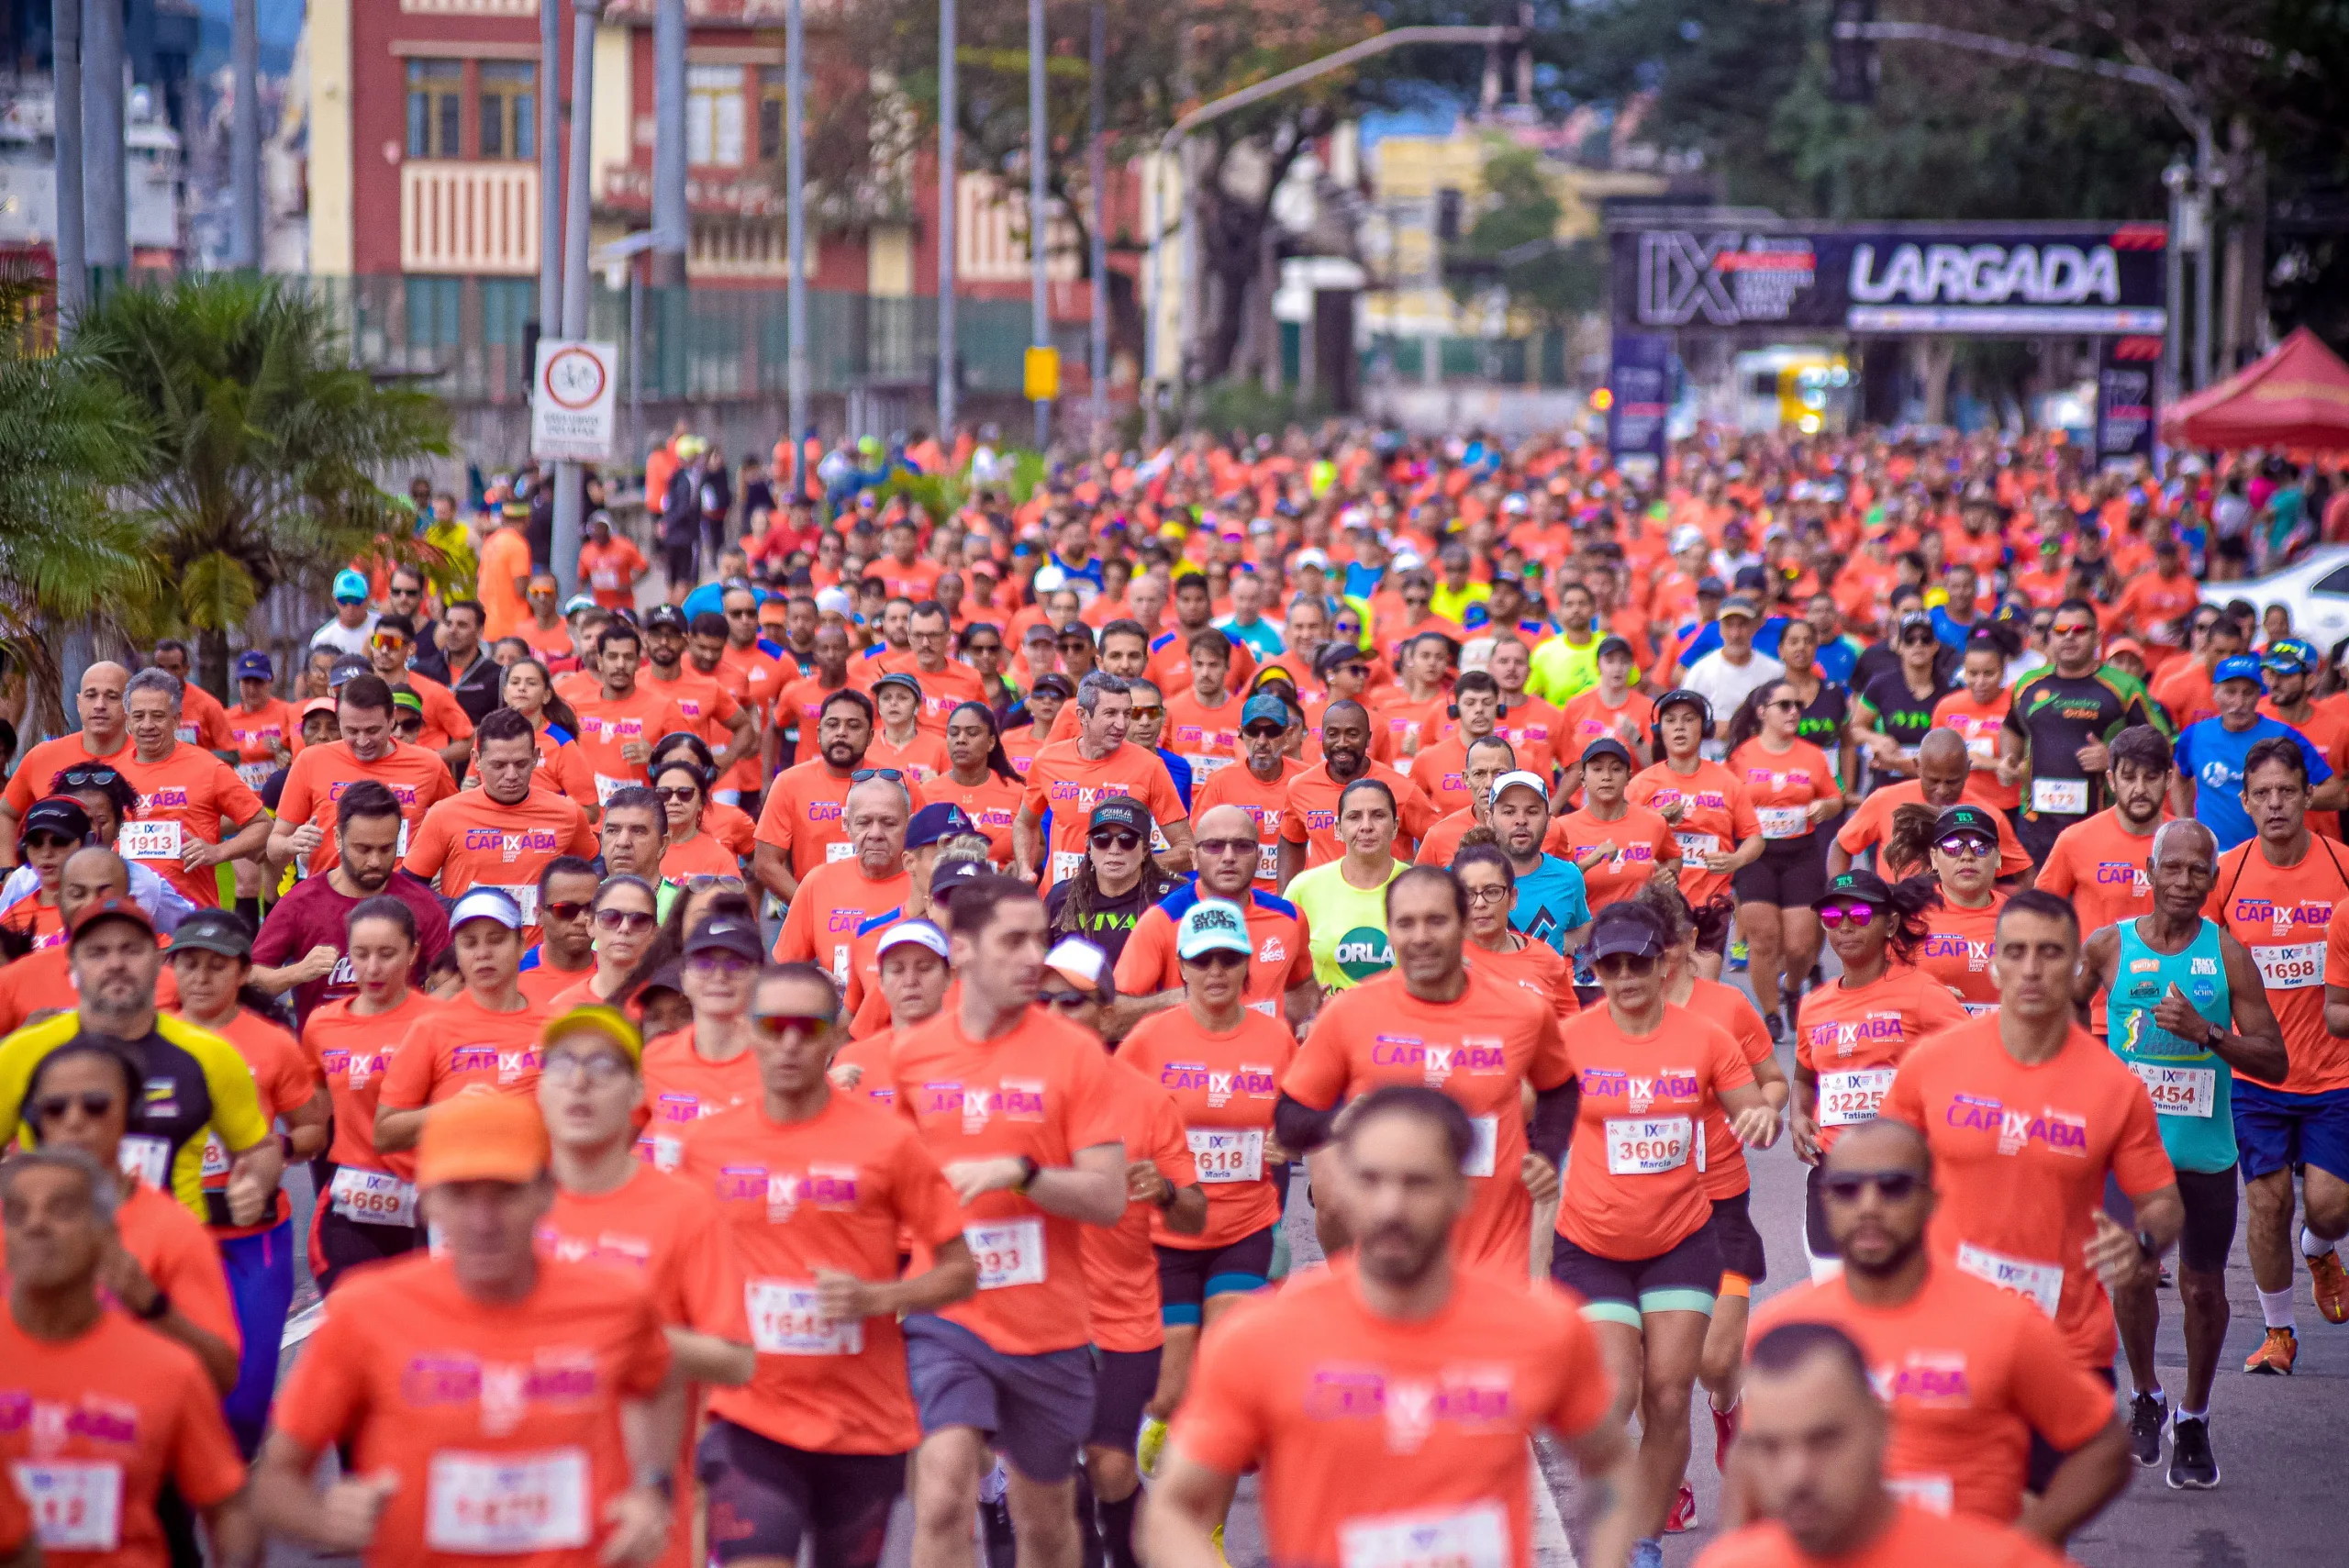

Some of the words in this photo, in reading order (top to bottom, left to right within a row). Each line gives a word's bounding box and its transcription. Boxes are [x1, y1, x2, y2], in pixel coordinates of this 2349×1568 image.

[1848, 242, 2121, 304] LARGADA
[144, 824, 155, 834] IX
[128, 836, 172, 851] 1913
[465, 834, 556, 851] CAPIXABA
[2235, 905, 2332, 925] CAPIXABA
[2191, 957, 2215, 967] TRACK
[2281, 948, 2294, 961] IX
[2264, 960, 2315, 979] 1698
[1813, 1019, 1903, 1046] APIXABA
[1372, 1044, 1505, 1071] CAPIXABA
[1162, 1072, 1274, 1094] CAPIXABA
[1848, 1075, 1861, 1088] IX
[2162, 1070, 2176, 1083] IX
[1580, 1077, 1699, 1099] CAPIXABA
[1829, 1091, 1884, 1113] 3225
[1644, 1123, 1658, 1137] IX
[1947, 1104, 2086, 1150] CAPIXABA
[1209, 1136, 1223, 1149] IX
[1620, 1140, 1680, 1161] 3606
[1640, 1160, 1672, 1169] Marcia
[367, 1175, 381, 1189] IX
[1204, 1171, 1231, 1179] Maria
[341, 1188, 401, 1213] 3669
[1998, 1263, 2013, 1282] IX
